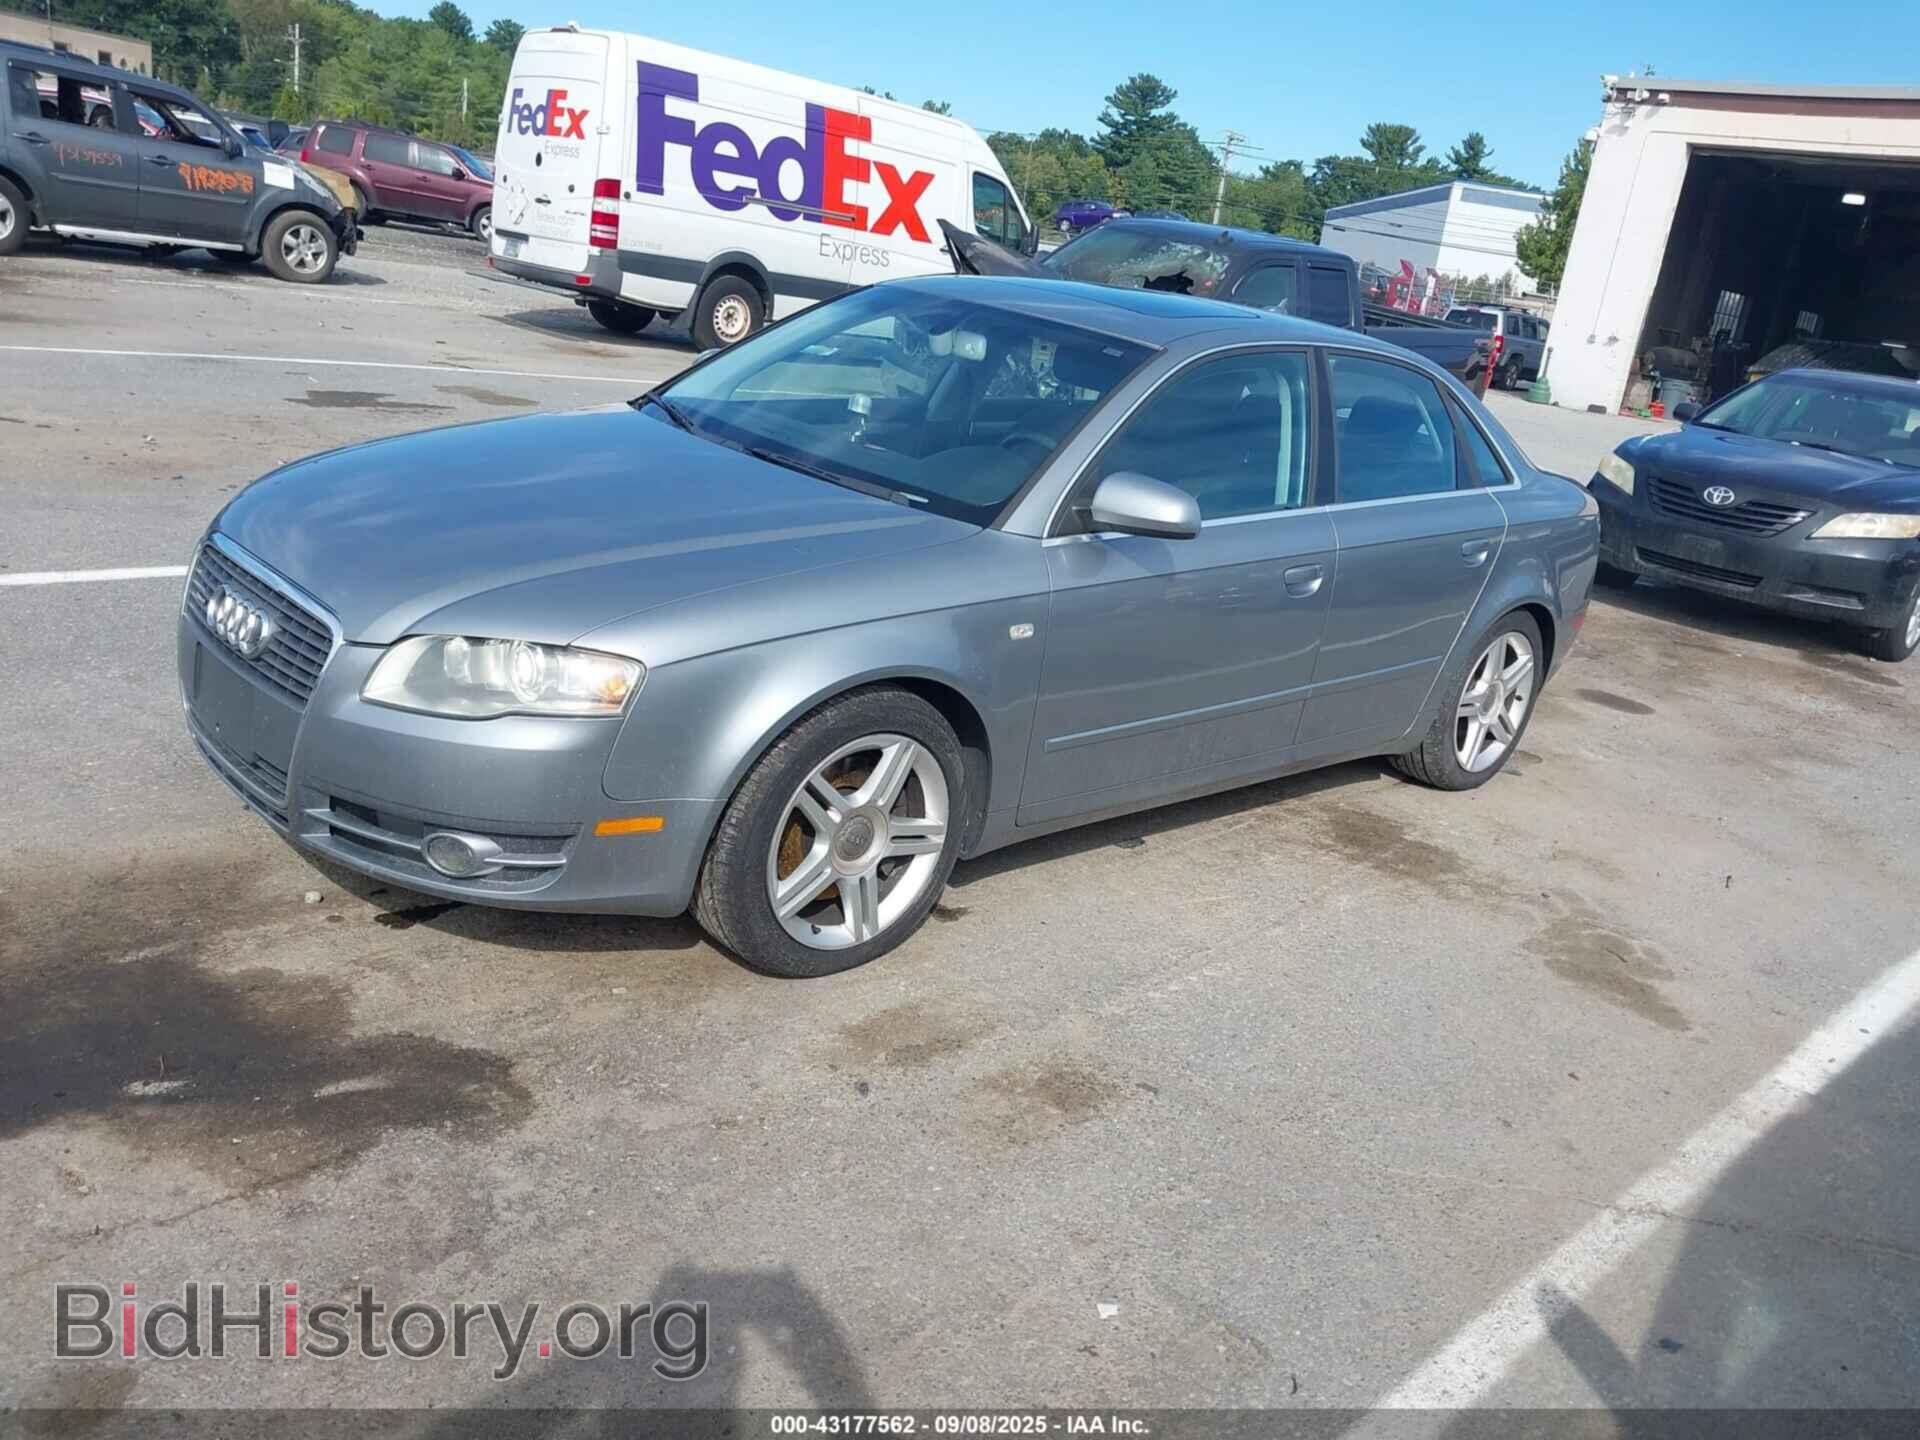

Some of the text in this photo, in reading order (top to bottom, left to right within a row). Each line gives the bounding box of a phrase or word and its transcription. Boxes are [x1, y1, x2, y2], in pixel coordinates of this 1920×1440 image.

[507, 88, 590, 139] FedEx
[544, 140, 580, 159] Express
[637, 60, 935, 243] FedEx
[819, 233, 890, 267] Express
